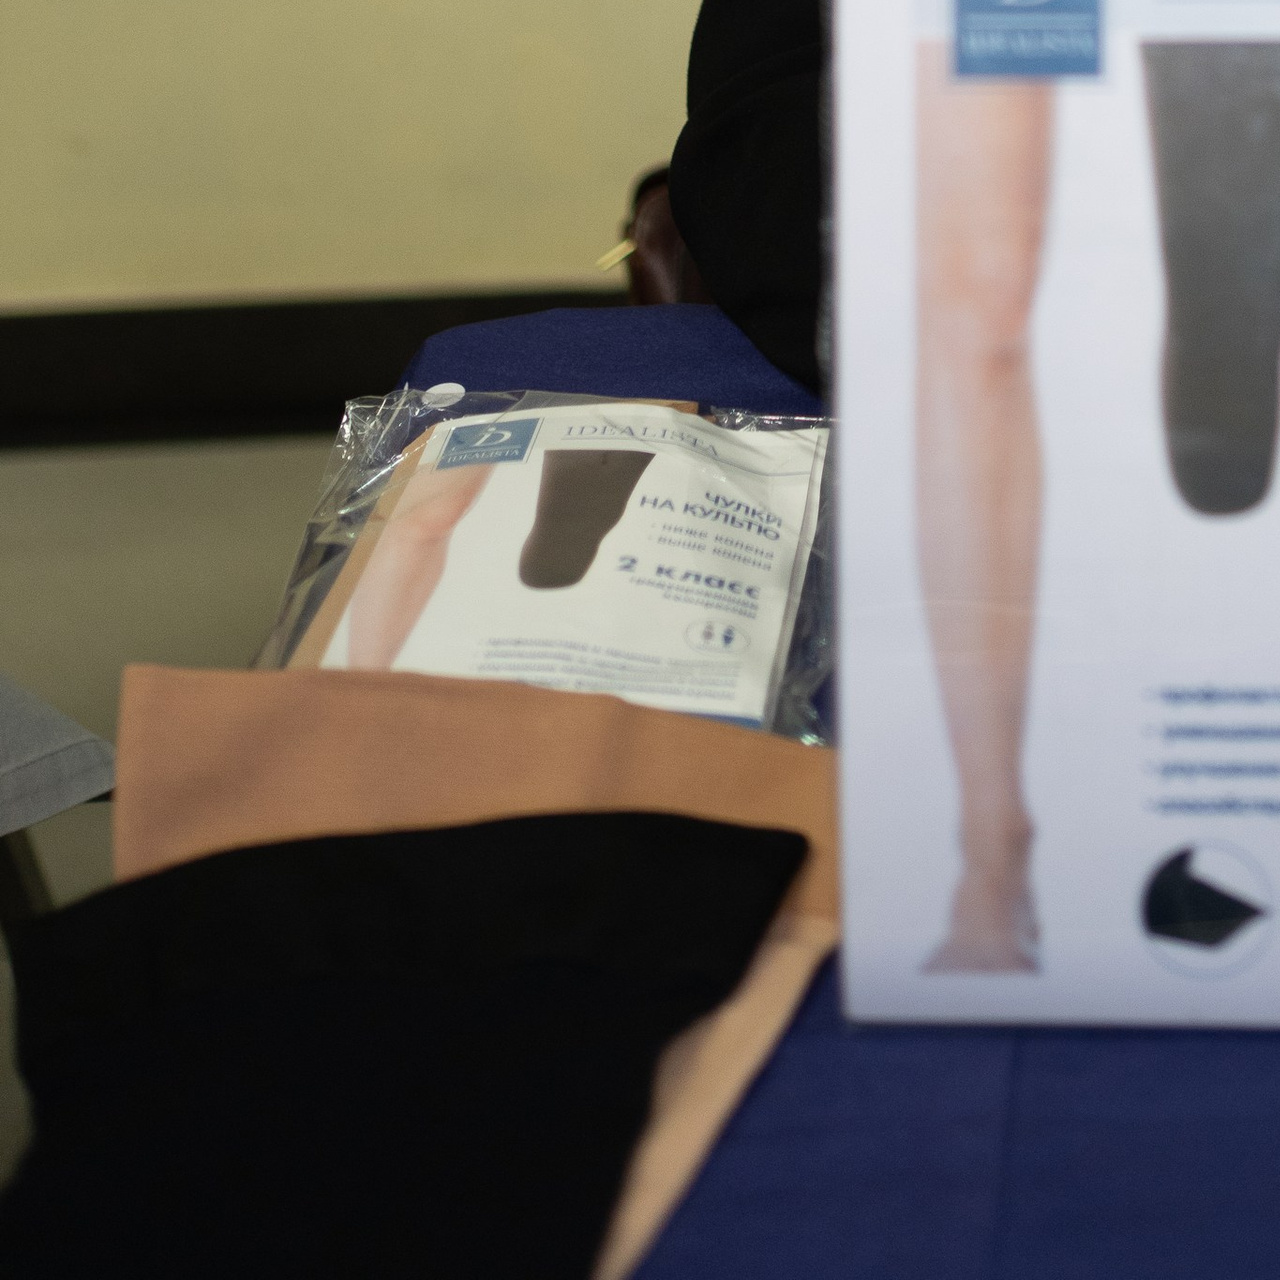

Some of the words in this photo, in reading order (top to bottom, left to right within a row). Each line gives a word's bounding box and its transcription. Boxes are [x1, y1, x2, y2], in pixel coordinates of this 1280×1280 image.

[447, 448, 521, 464] IDEALISTA
[565, 423, 719, 457] IDEALISTA
[640, 495, 675, 512] НА
[682, 502, 781, 541] КУЛЬТЮ
[704, 491, 783, 529] ЧУЛКИ
[617, 555, 639, 572] 2
[655, 564, 762, 600] класс
